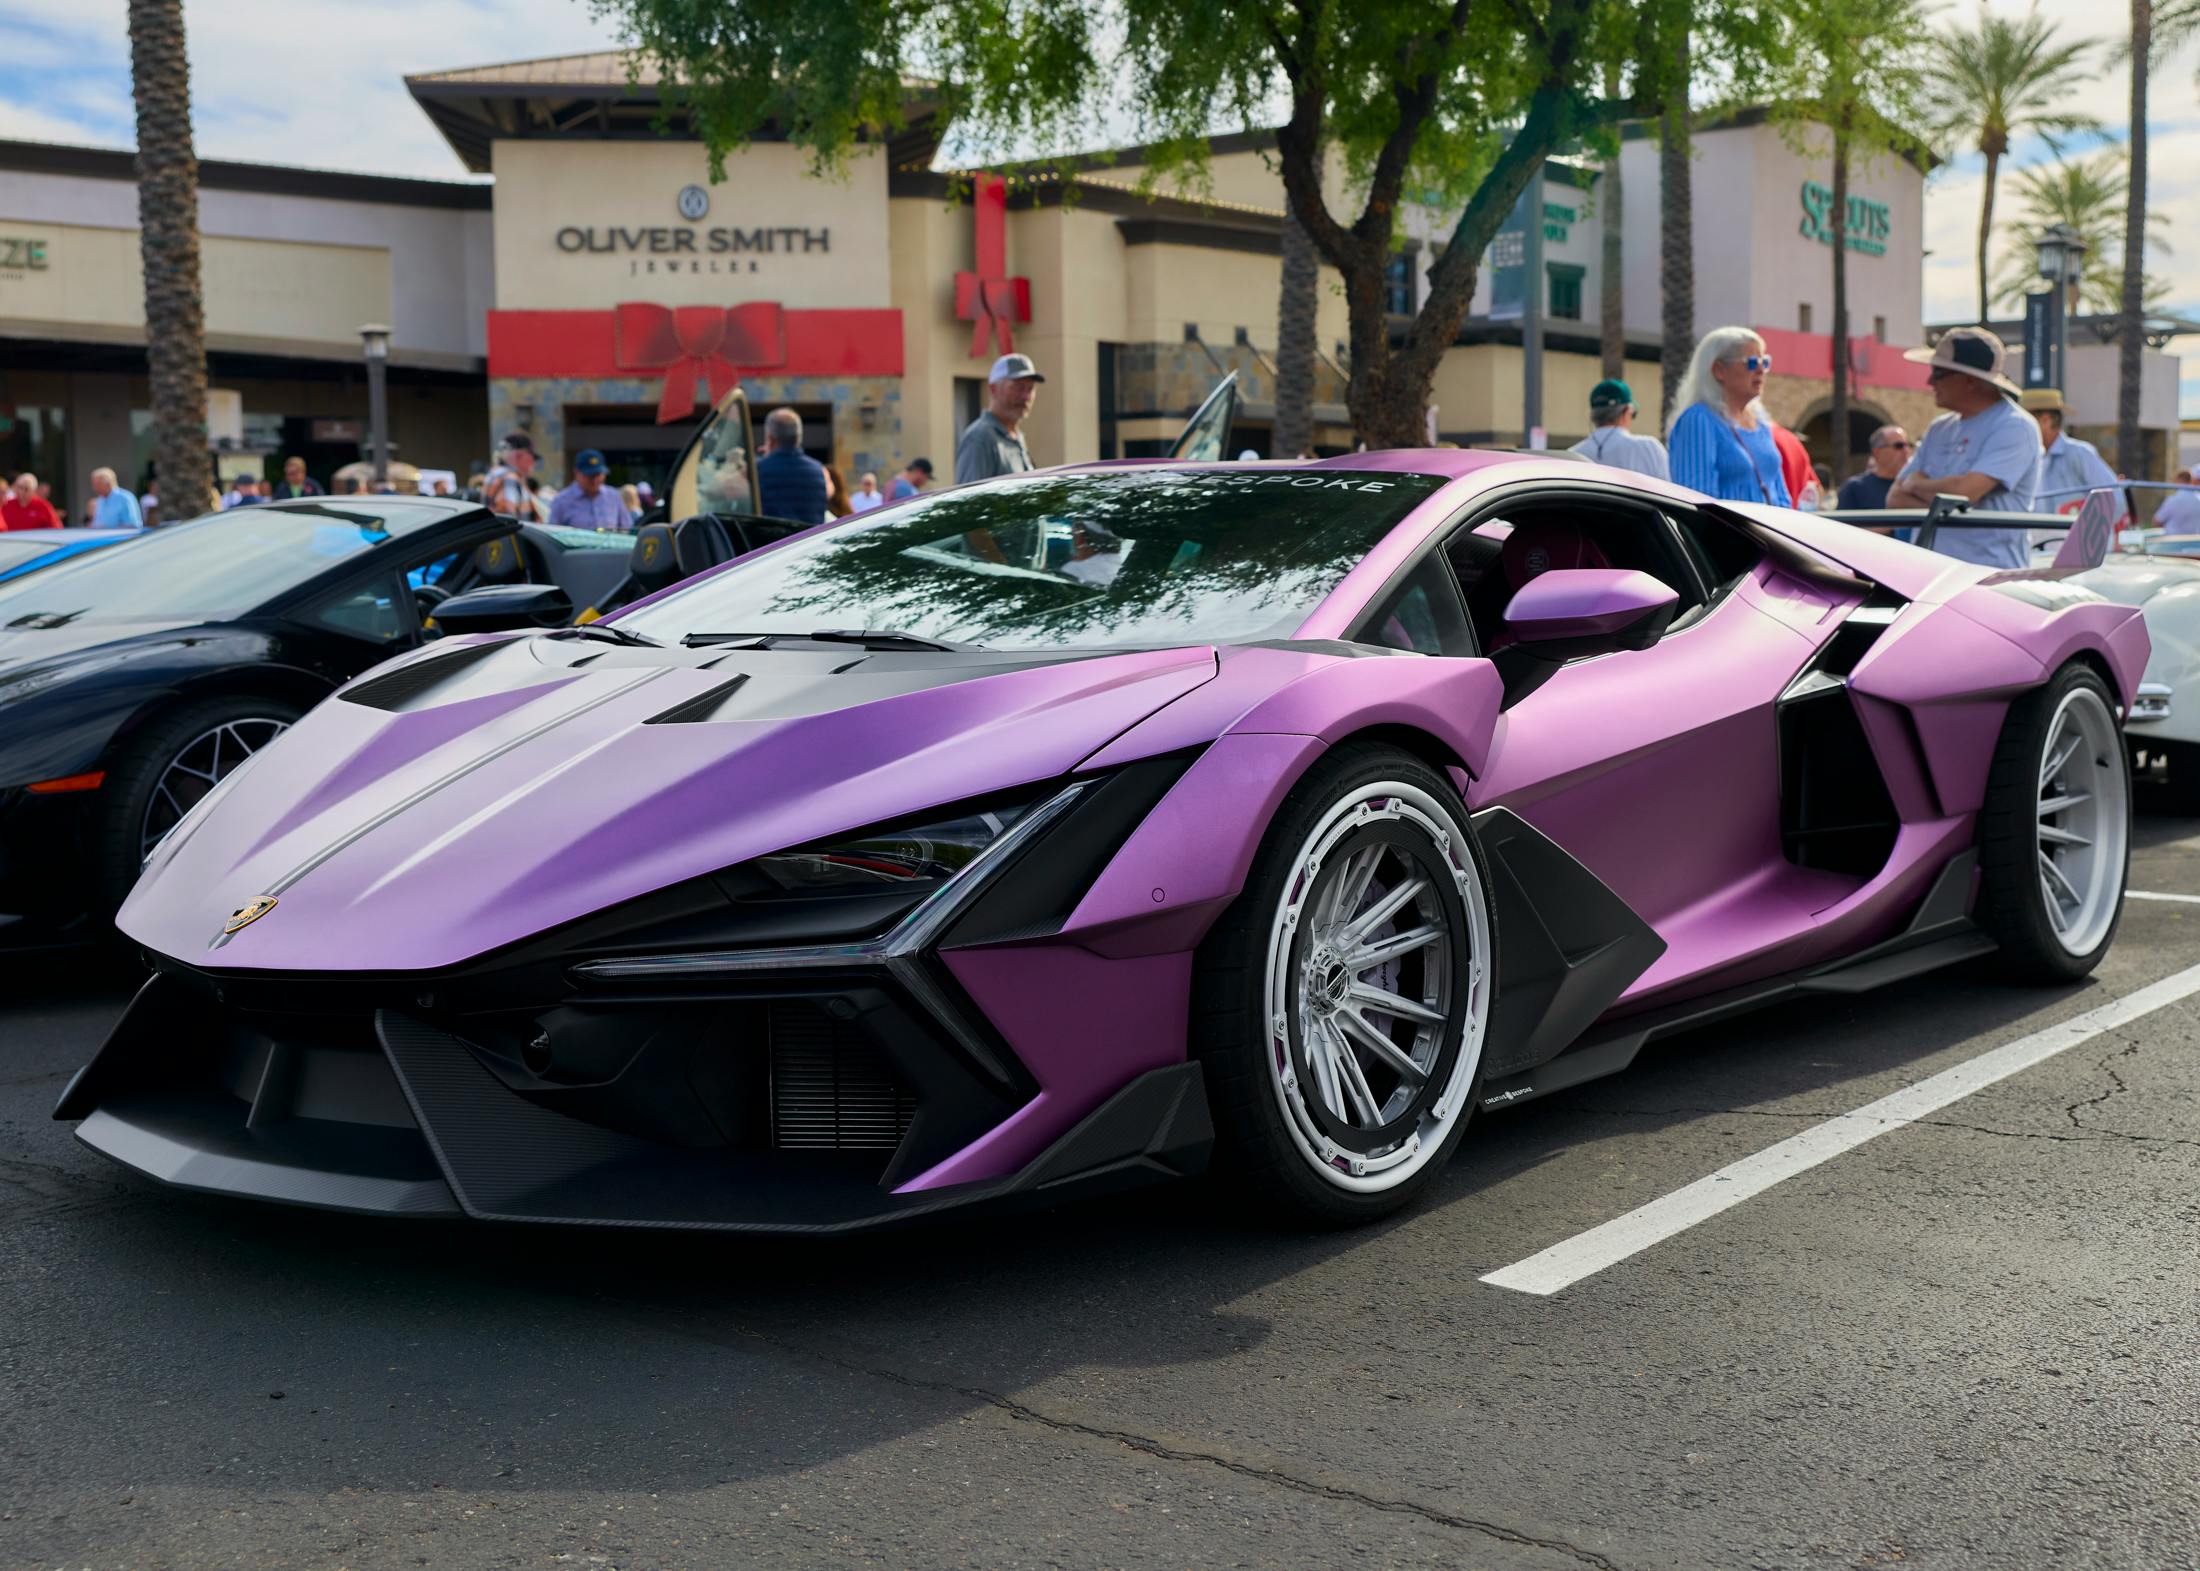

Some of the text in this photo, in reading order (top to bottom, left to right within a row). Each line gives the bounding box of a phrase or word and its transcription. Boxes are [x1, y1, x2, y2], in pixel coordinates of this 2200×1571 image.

[556, 226, 830, 253] OLIVER SMITH
[630, 260, 759, 276] JEWELER
